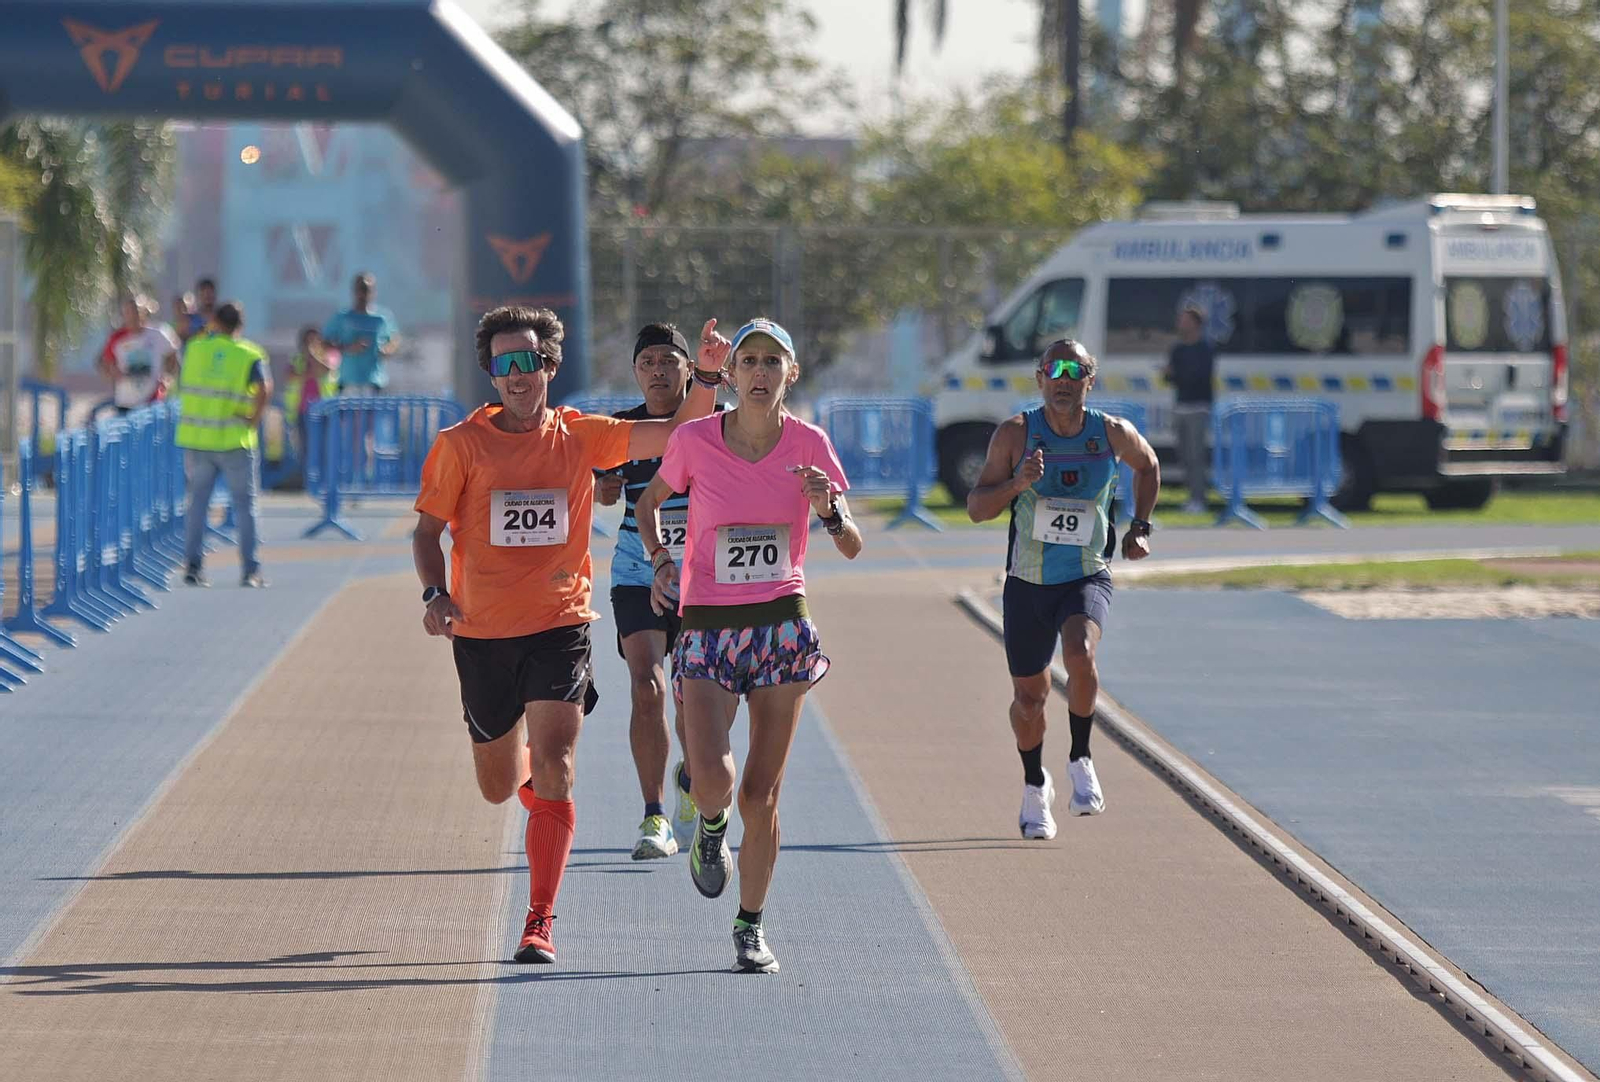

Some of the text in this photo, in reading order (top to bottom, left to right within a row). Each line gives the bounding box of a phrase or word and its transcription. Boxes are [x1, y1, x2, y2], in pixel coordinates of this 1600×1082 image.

[163, 45, 344, 68] CUPRA
[176, 81, 332, 102] TURIAL
[1114, 239, 1254, 261] AMBULANCIA
[504, 508, 556, 530] 204
[1051, 514, 1079, 532] 49
[727, 544, 778, 568] 270
